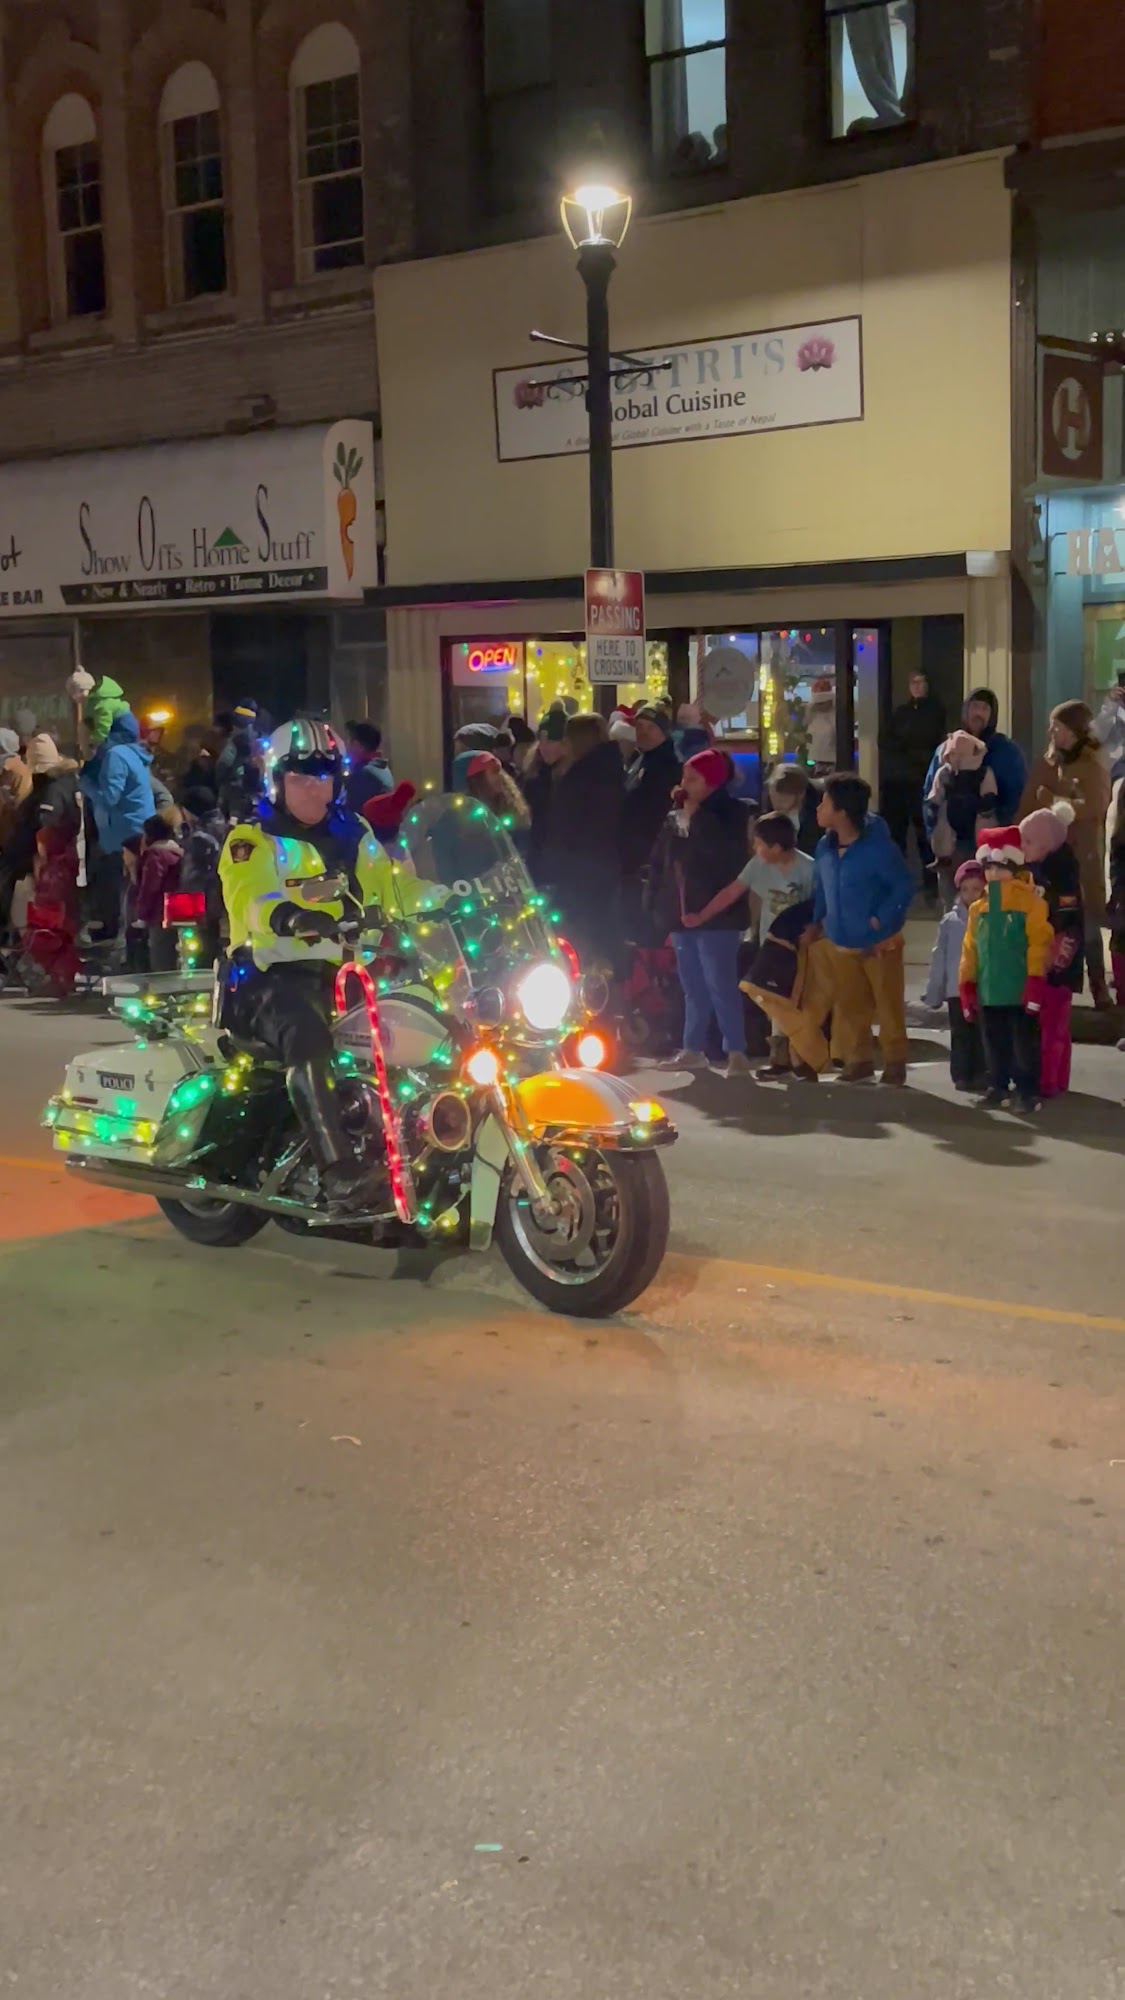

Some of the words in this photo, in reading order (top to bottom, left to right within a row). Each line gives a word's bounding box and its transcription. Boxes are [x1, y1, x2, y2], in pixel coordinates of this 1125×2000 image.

[666, 388, 746, 415] Cuisine
[714, 418, 735, 430] Taste
[738, 416, 748, 427] of
[750, 412, 776, 425] Nepal
[79, 502, 132, 576] Show
[192, 528, 250, 568] Home
[256, 484, 315, 563] Stuff
[185, 578, 216, 594] Retro
[269, 572, 303, 588] Decor
[13, 589, 43, 605] BAR
[590, 605, 640, 631] PASSING
[469, 647, 516, 671] OPEN
[597, 640, 620, 657] HERE
[625, 640, 636, 657] TO
[595, 659, 640, 677] CROSSING
